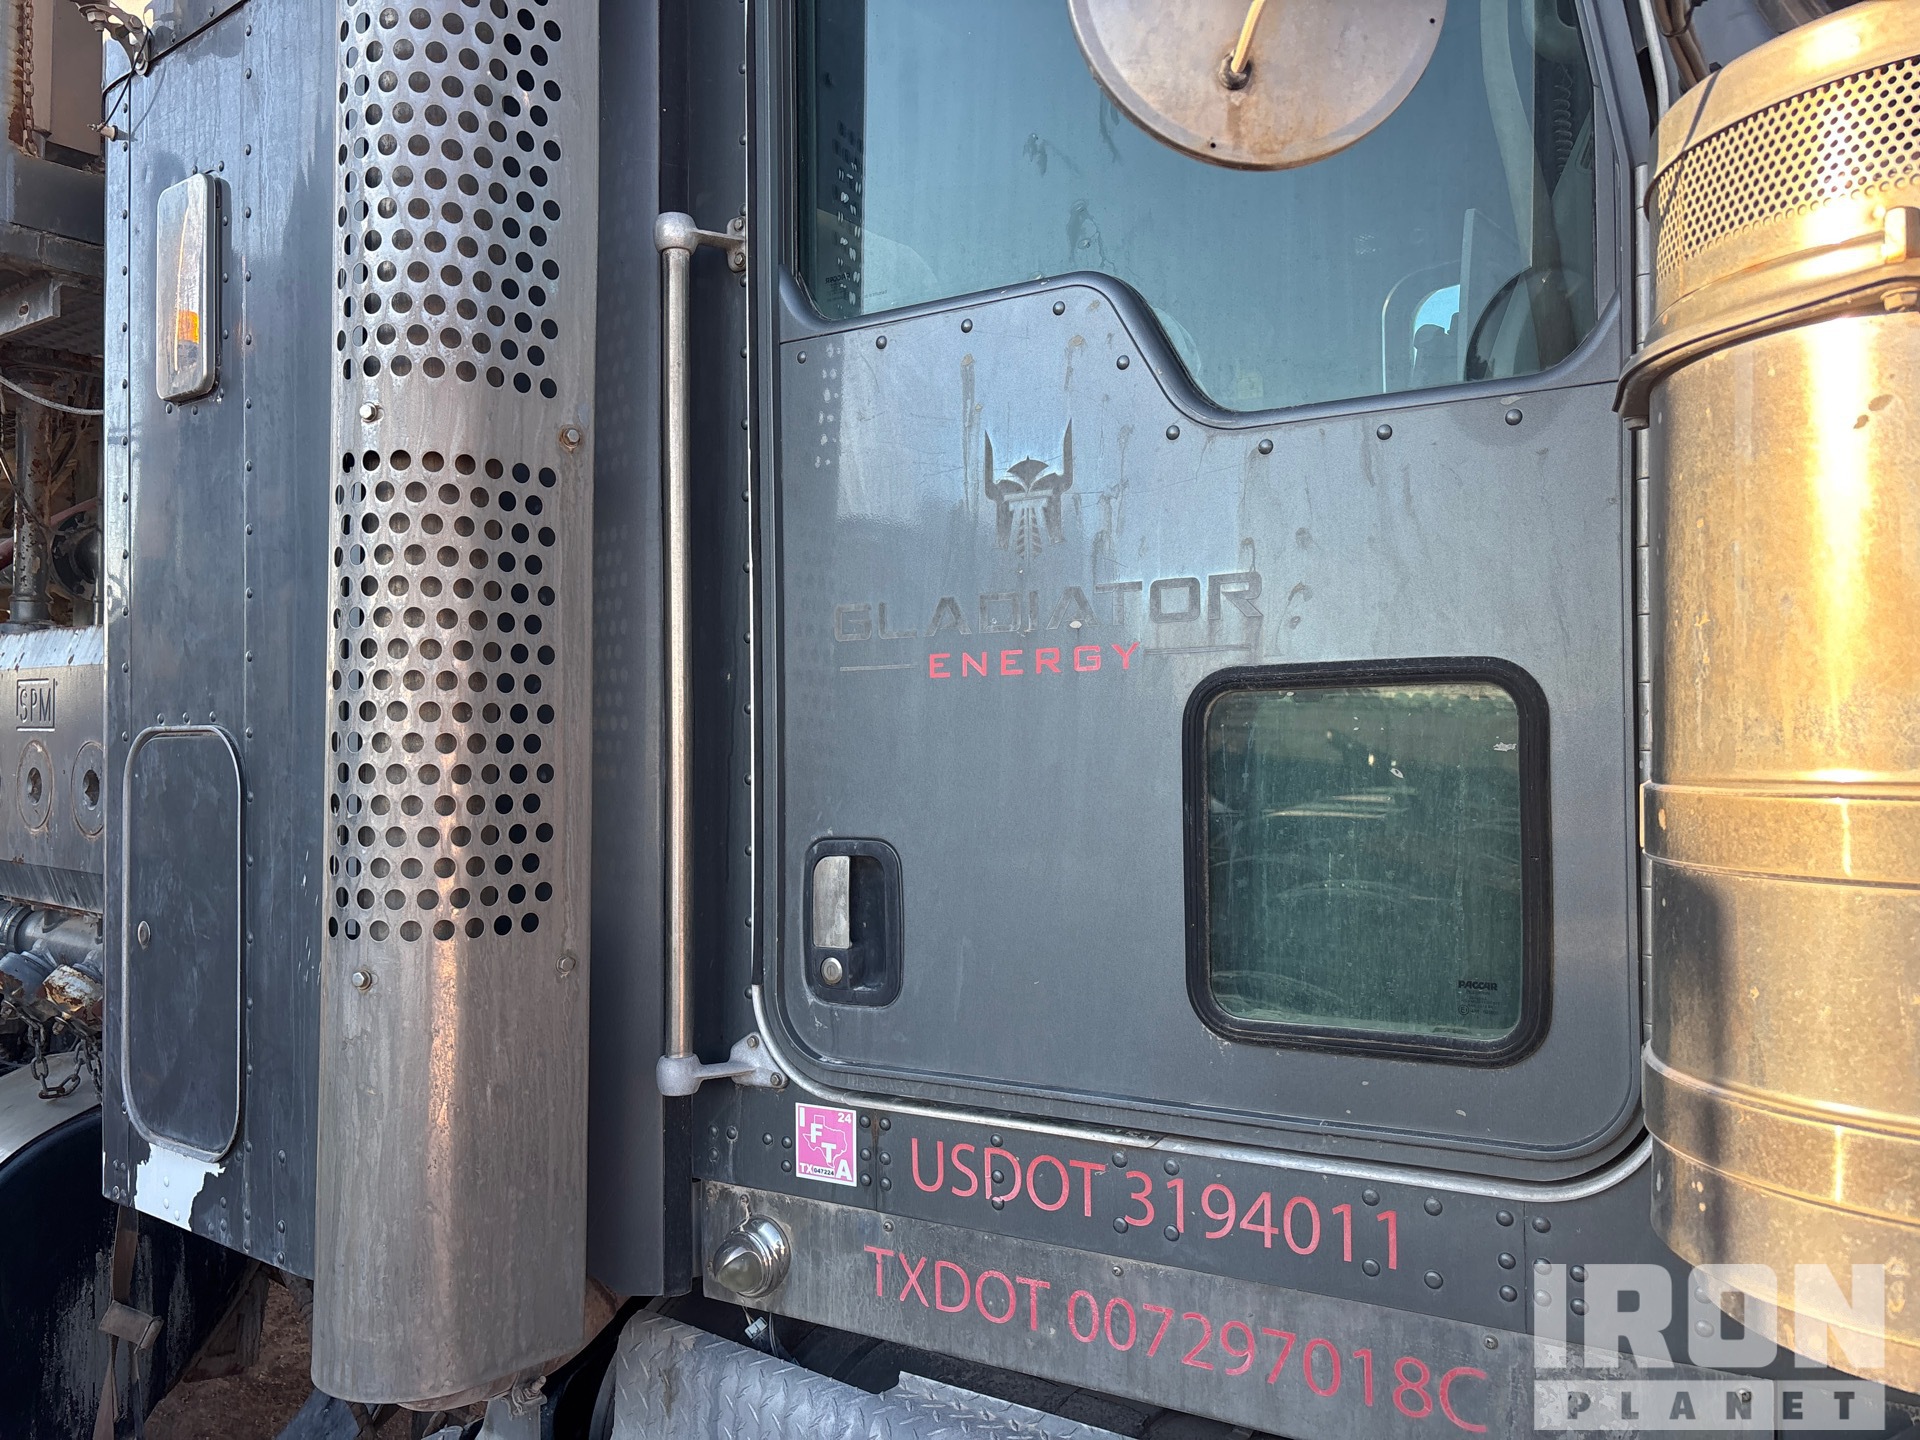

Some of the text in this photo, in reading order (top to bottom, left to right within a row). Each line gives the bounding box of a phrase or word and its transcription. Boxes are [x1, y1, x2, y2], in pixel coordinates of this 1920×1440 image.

[834, 571, 1263, 642] GLADIATOR
[928, 642, 1141, 679] ENERGY
[20, 688, 51, 723] SPM
[1458, 980, 1498, 991] PACCAR
[837, 1112, 852, 1124] 24
[799, 1162, 814, 1174] TX
[911, 1137, 1399, 1270] USDOT 3194011
[863, 1244, 1487, 1433] TXDOT 007297018C
